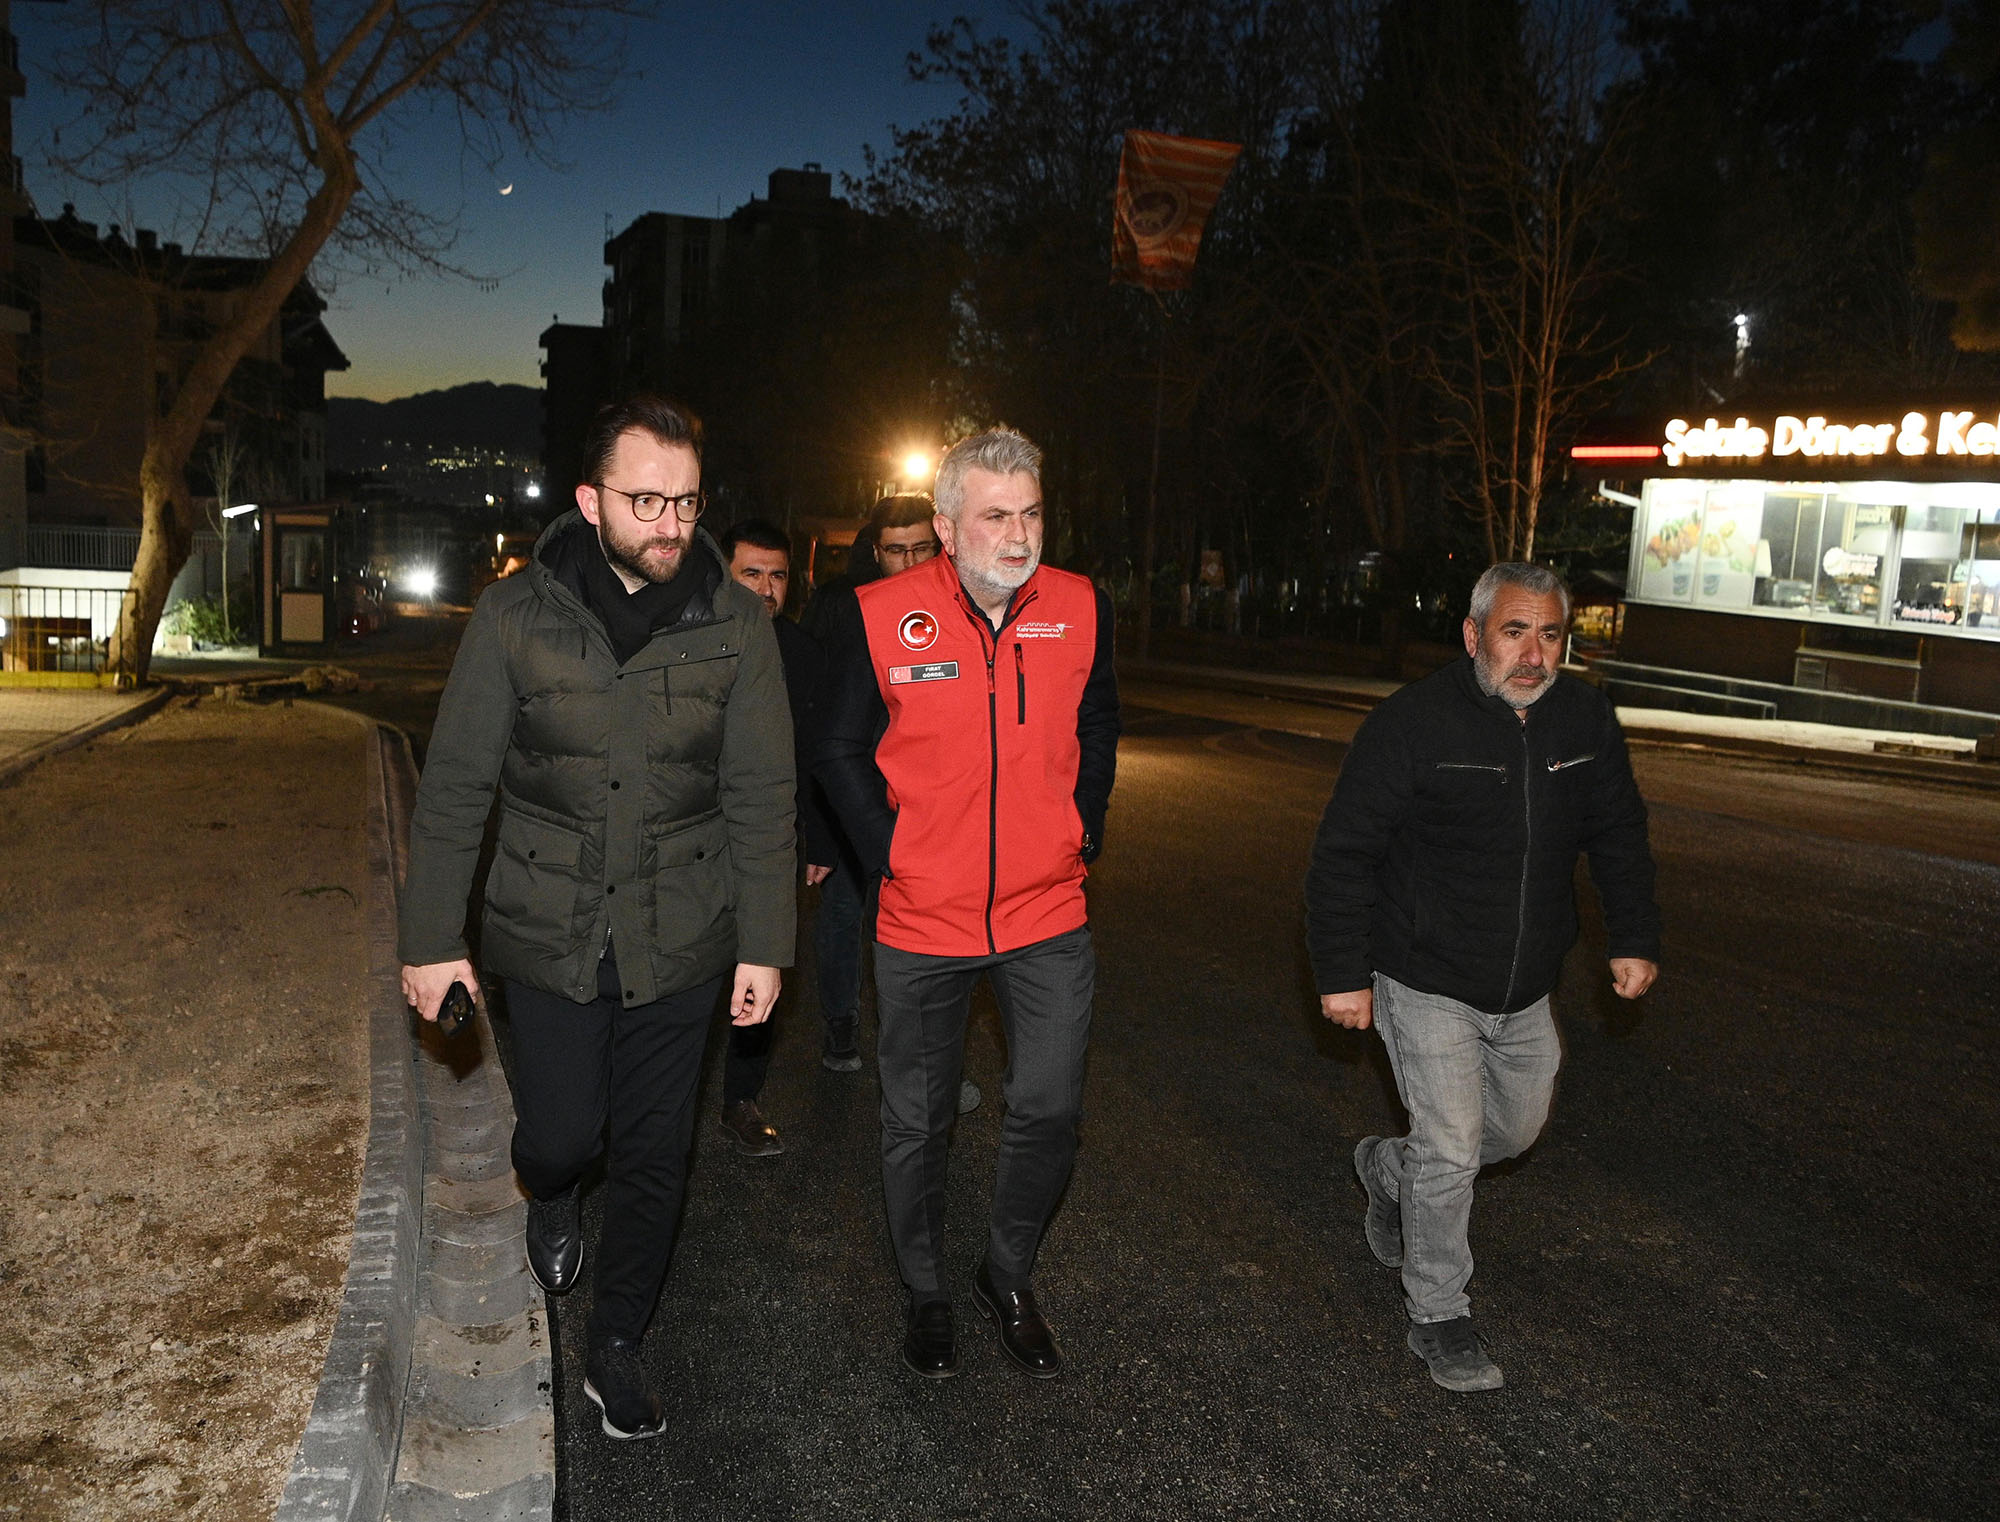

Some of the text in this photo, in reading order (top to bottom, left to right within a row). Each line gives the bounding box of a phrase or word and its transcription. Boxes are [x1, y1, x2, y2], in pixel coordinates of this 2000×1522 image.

[1773, 416, 1895, 456] Döner
[1896, 411, 1930, 456] &
[1936, 411, 2000, 456] Ke
